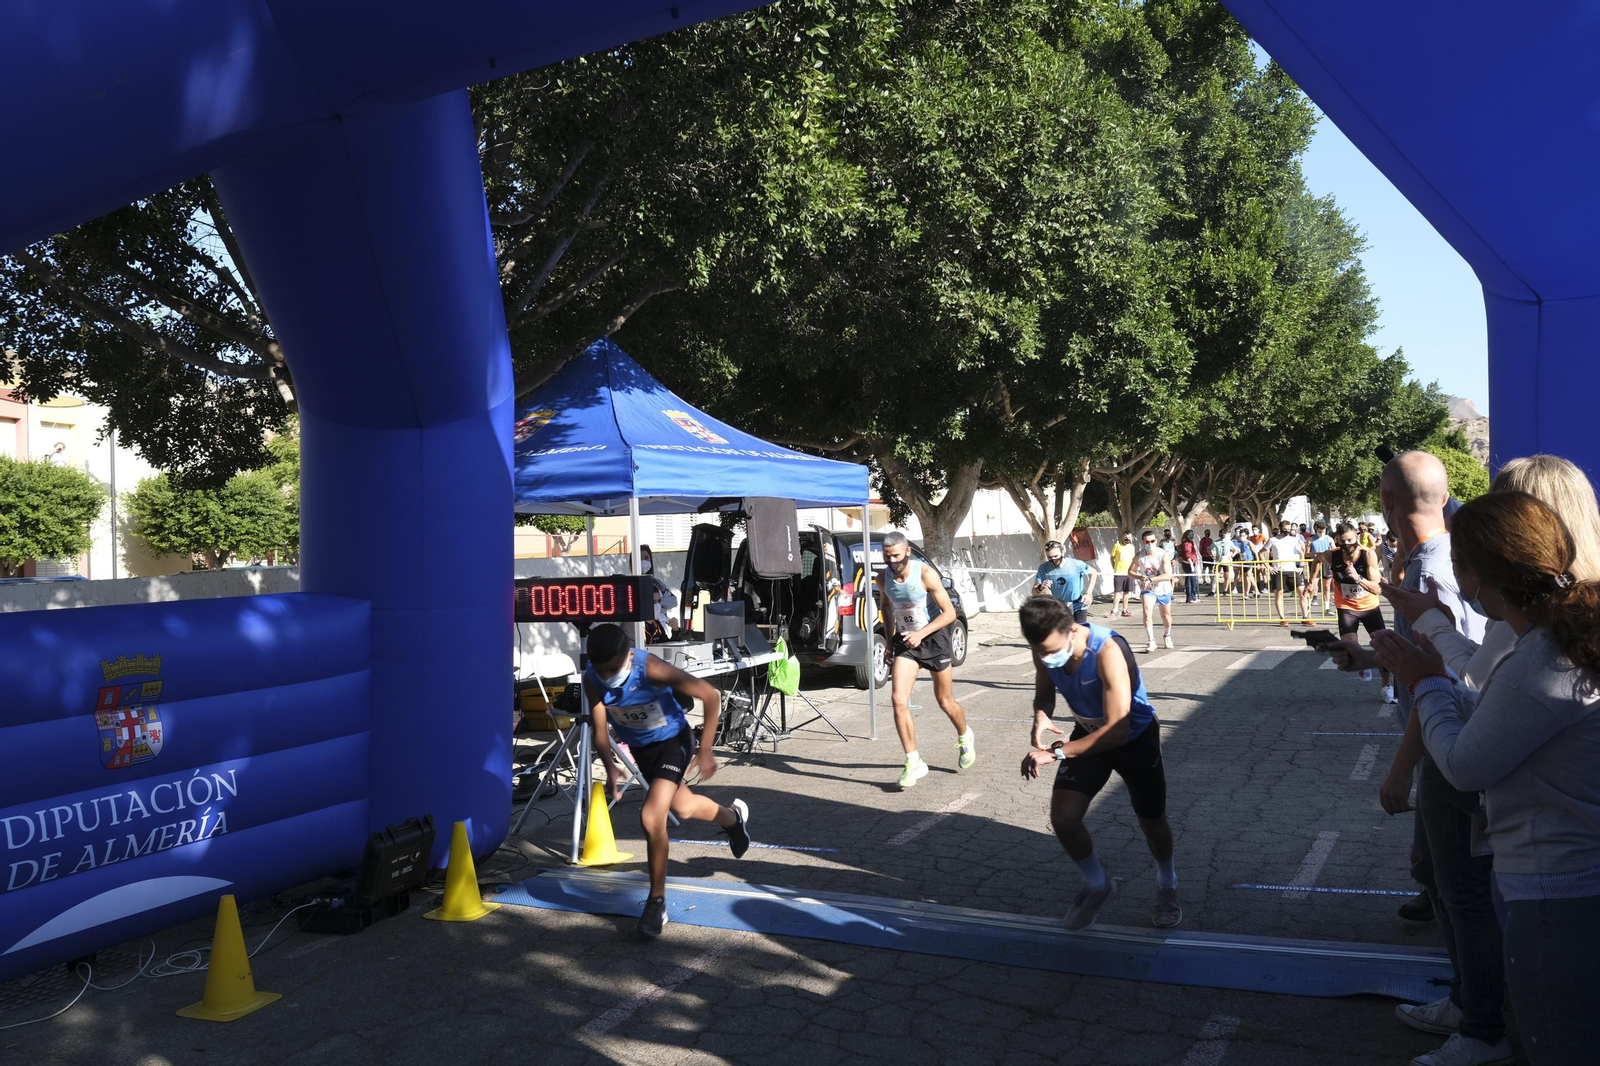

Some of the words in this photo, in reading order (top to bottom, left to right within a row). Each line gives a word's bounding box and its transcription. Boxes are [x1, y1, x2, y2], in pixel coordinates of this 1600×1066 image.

[903, 615, 914, 623] 82
[623, 712, 648, 720] 193
[0, 769, 238, 850] DIPUTACIÓN
[7, 852, 61, 892] DE
[69, 807, 228, 874] ALMERÍA
